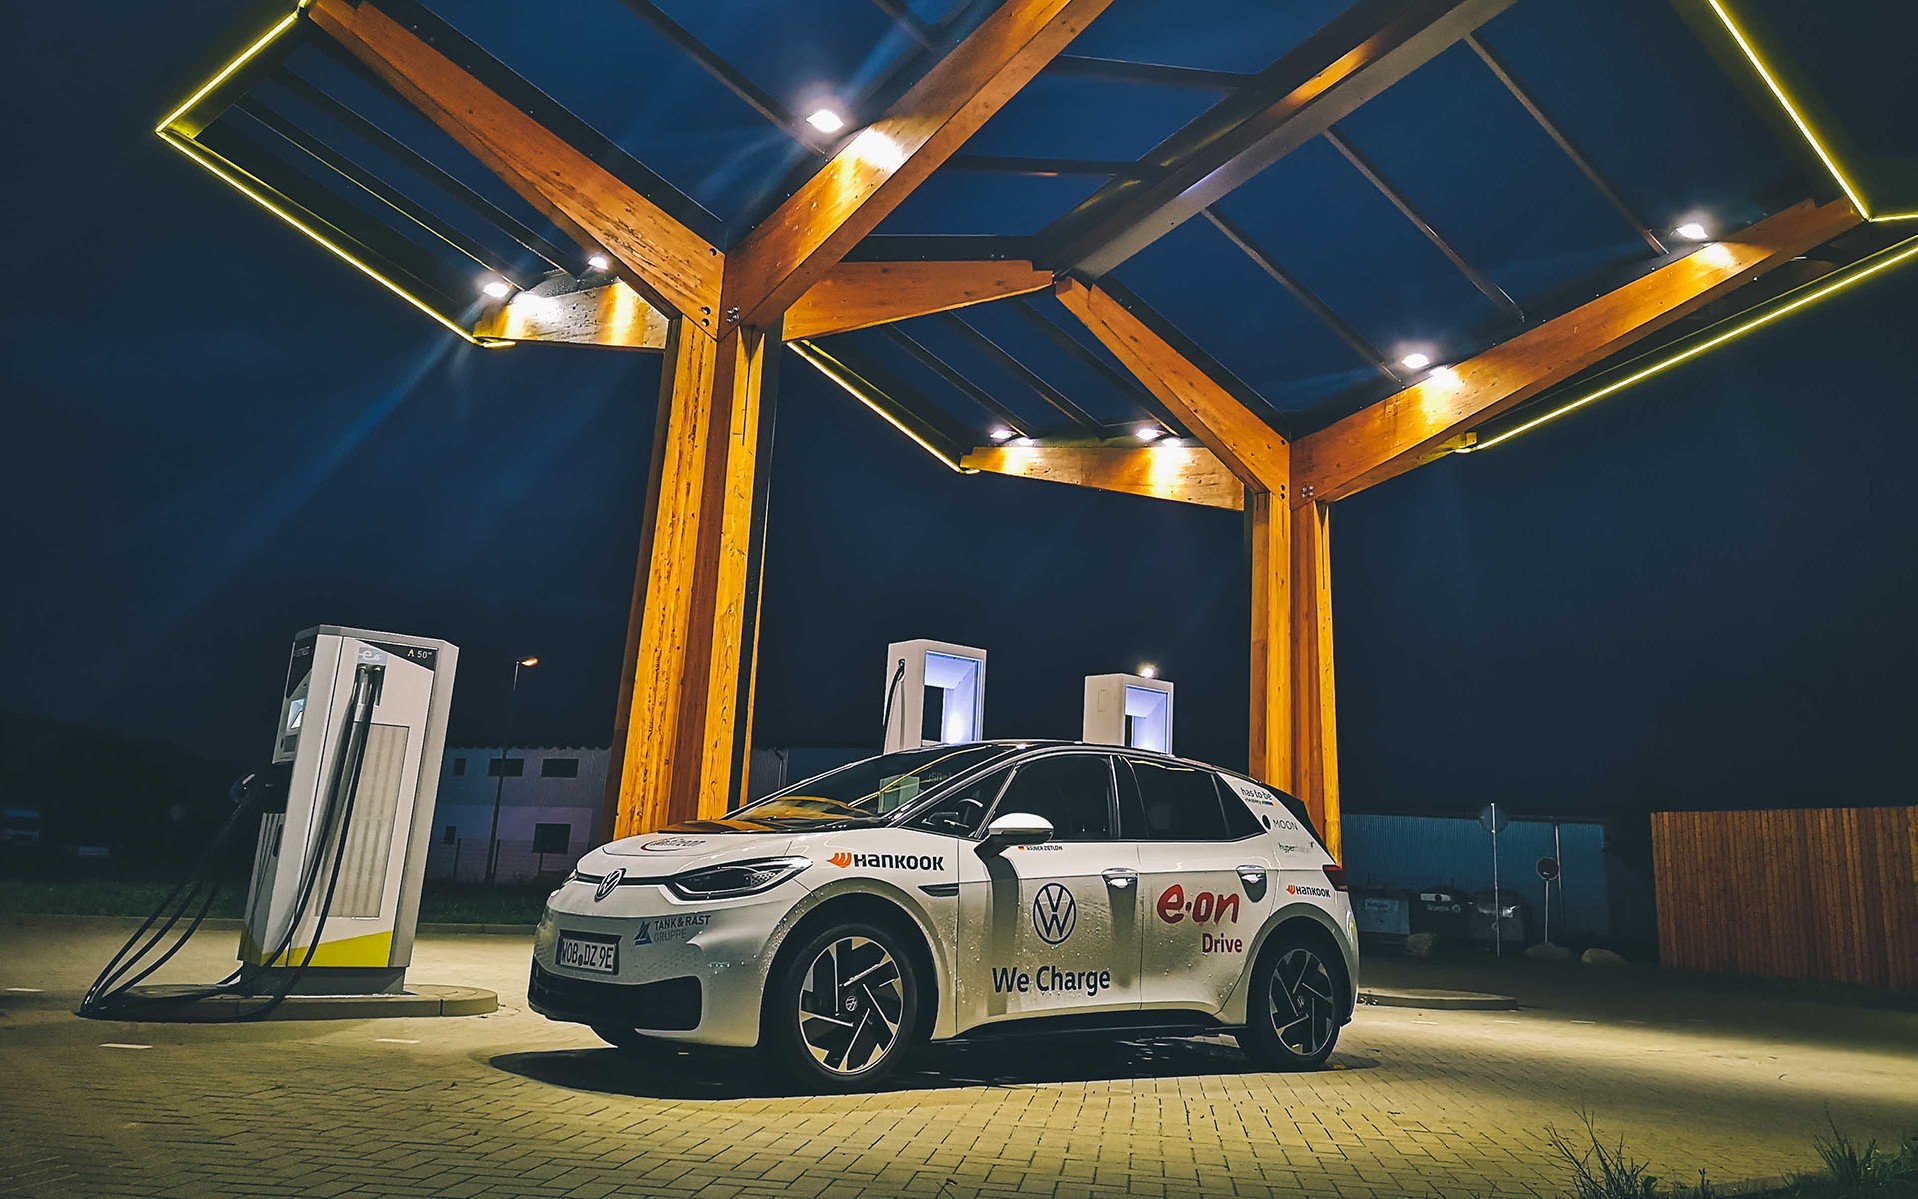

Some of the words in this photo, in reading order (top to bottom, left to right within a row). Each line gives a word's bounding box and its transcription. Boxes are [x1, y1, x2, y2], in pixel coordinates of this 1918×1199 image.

[1273, 819, 1298, 831] MOON
[655, 929, 687, 942] GRUPPE
[1202, 933, 1243, 953] Drive
[583, 945, 597, 967] DZ
[599, 947, 614, 969] 9E
[992, 967, 1030, 993] We
[1036, 965, 1111, 997] Charge
